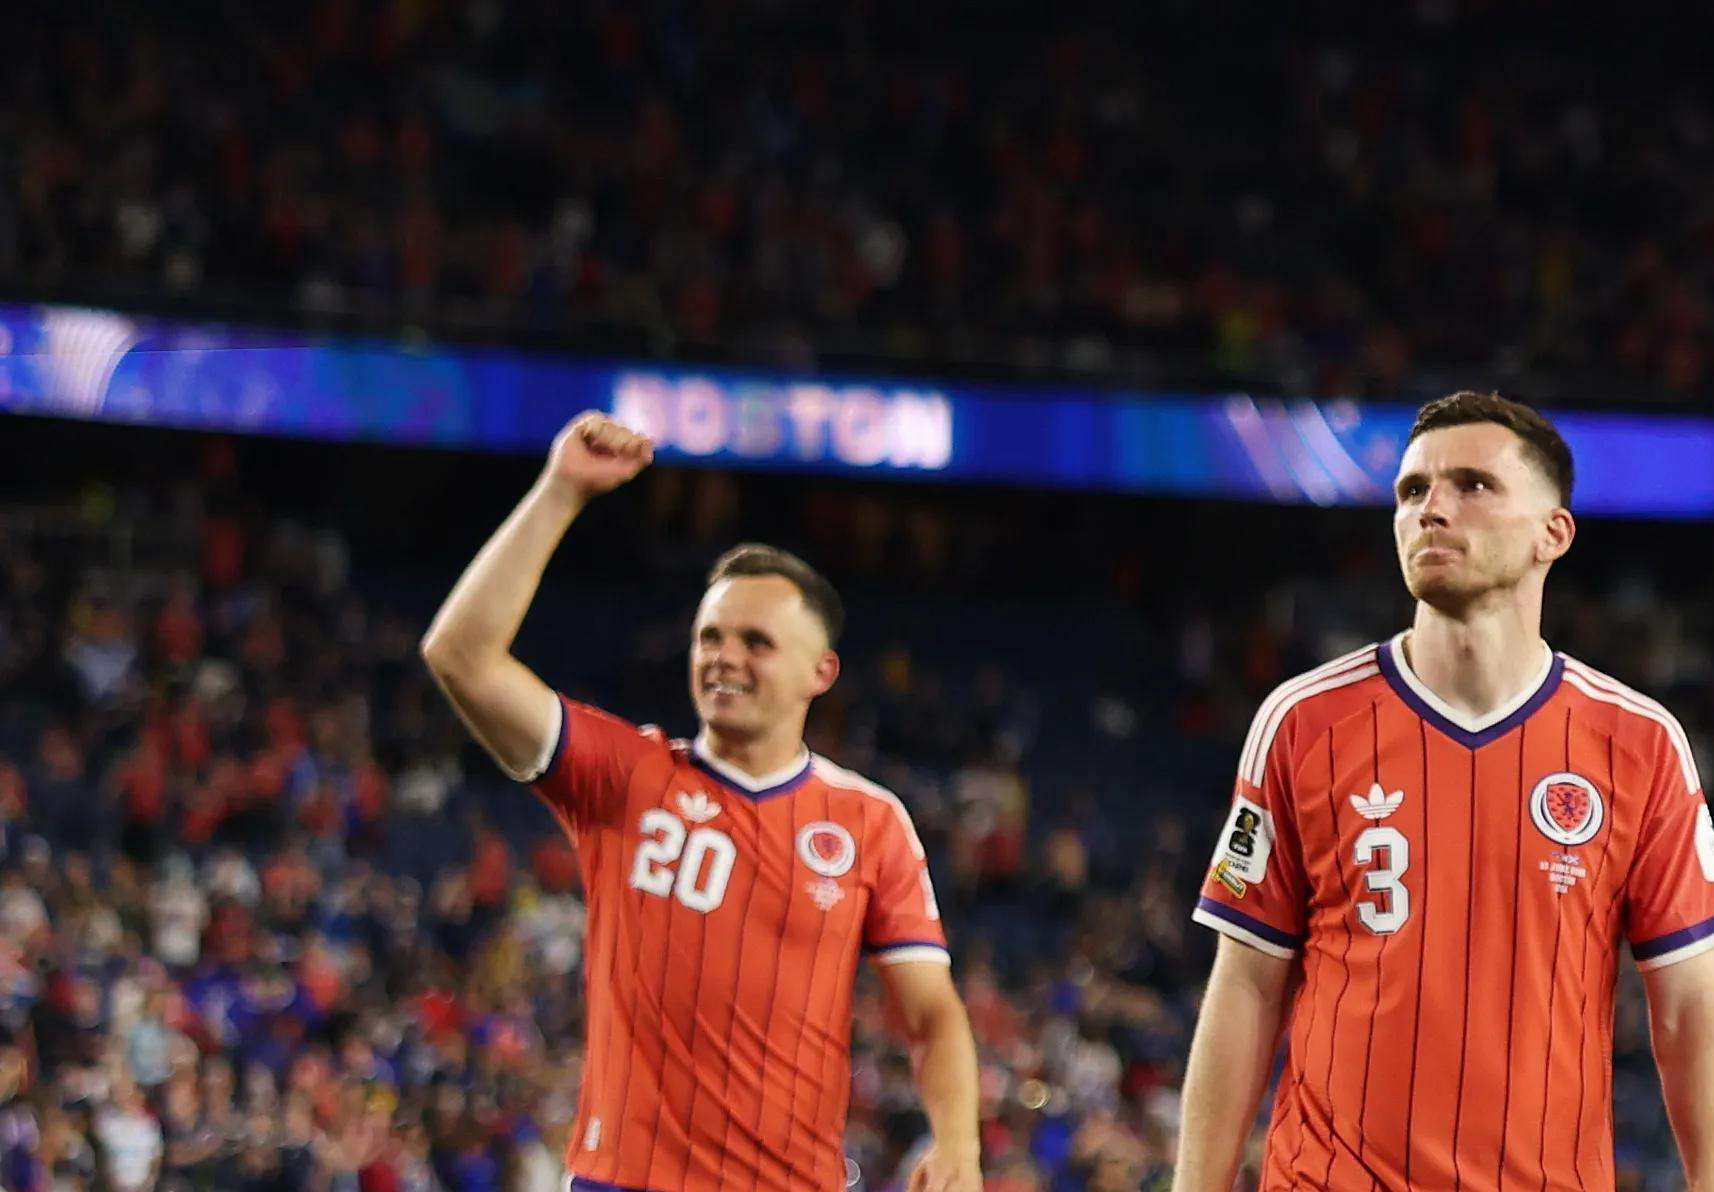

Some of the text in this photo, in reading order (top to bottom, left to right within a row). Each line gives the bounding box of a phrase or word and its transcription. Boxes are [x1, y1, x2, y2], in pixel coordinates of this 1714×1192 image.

[613, 372, 953, 471] BOSTON
[630, 807, 737, 914] 20
[1353, 826, 1411, 936] 3
